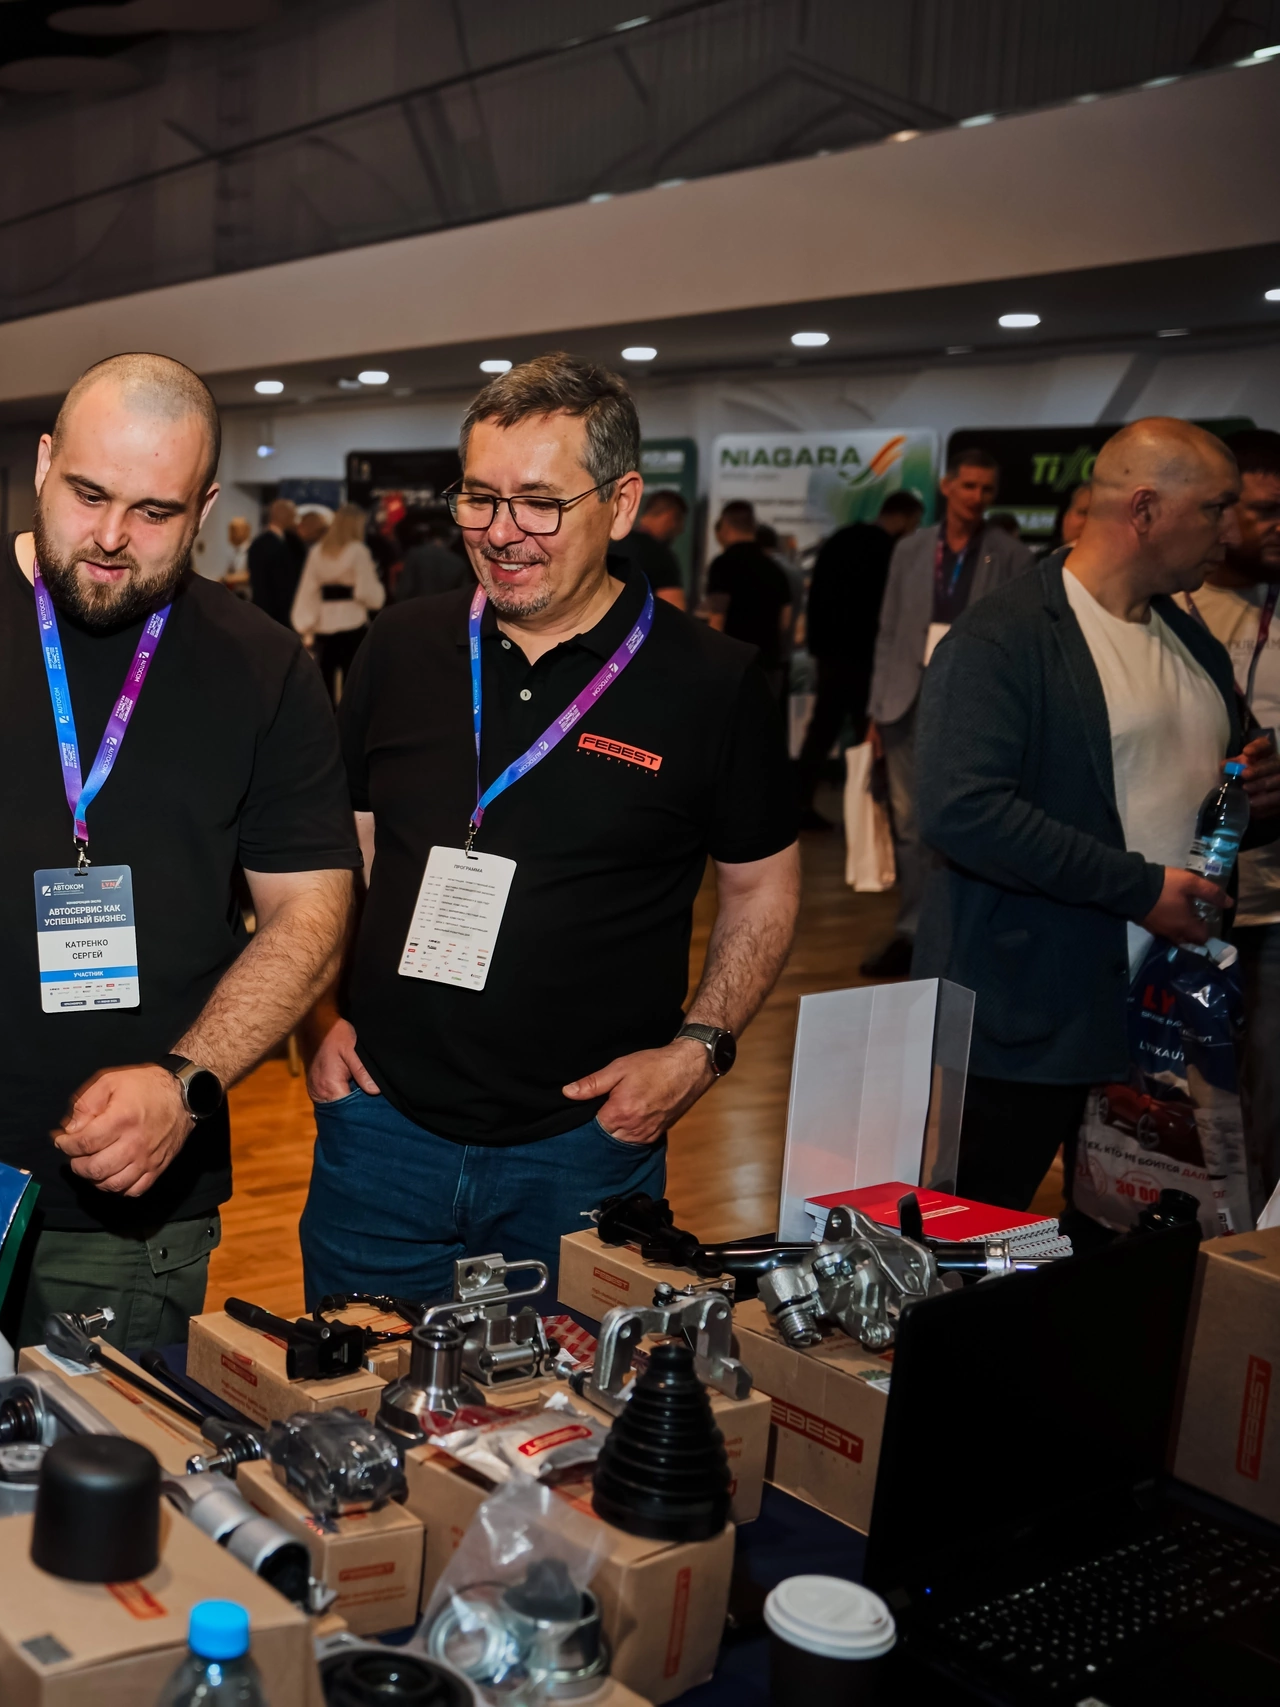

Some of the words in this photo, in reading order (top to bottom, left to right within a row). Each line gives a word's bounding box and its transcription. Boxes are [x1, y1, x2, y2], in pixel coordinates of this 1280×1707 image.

[721, 446, 861, 467] NIAGARA
[36, 595, 48, 621] AUTOCOM
[134, 659, 148, 683] AUTOCOM
[592, 672, 614, 698] AUTOCOM
[56, 687, 65, 714] AUTOCOM
[101, 747, 116, 774] AUTOCOM
[518, 750, 543, 773] AUTOCOM
[582, 736, 659, 766] FEBEST
[453, 864, 483, 874] ПРОГРАММА
[53, 883, 84, 892] АВТОКОМ
[44, 914, 93, 926] УСПЕШНЫЙ
[94, 913, 127, 923] БИЗНЕС
[49, 905, 103, 916] АВТОСЕРВИС
[104, 904, 121, 913] КАК
[65, 939, 109, 949] КАТРЕНКО
[72, 950, 103, 960] СЕРГЕЙ
[73, 970, 104, 978] УЧАСТНИК
[1138, 1158, 1180, 1174] БОИТСЯ
[1116, 1179, 1132, 1196] 30
[1240, 1359, 1268, 1476] FEBEST
[771, 1402, 859, 1455] EBEST
